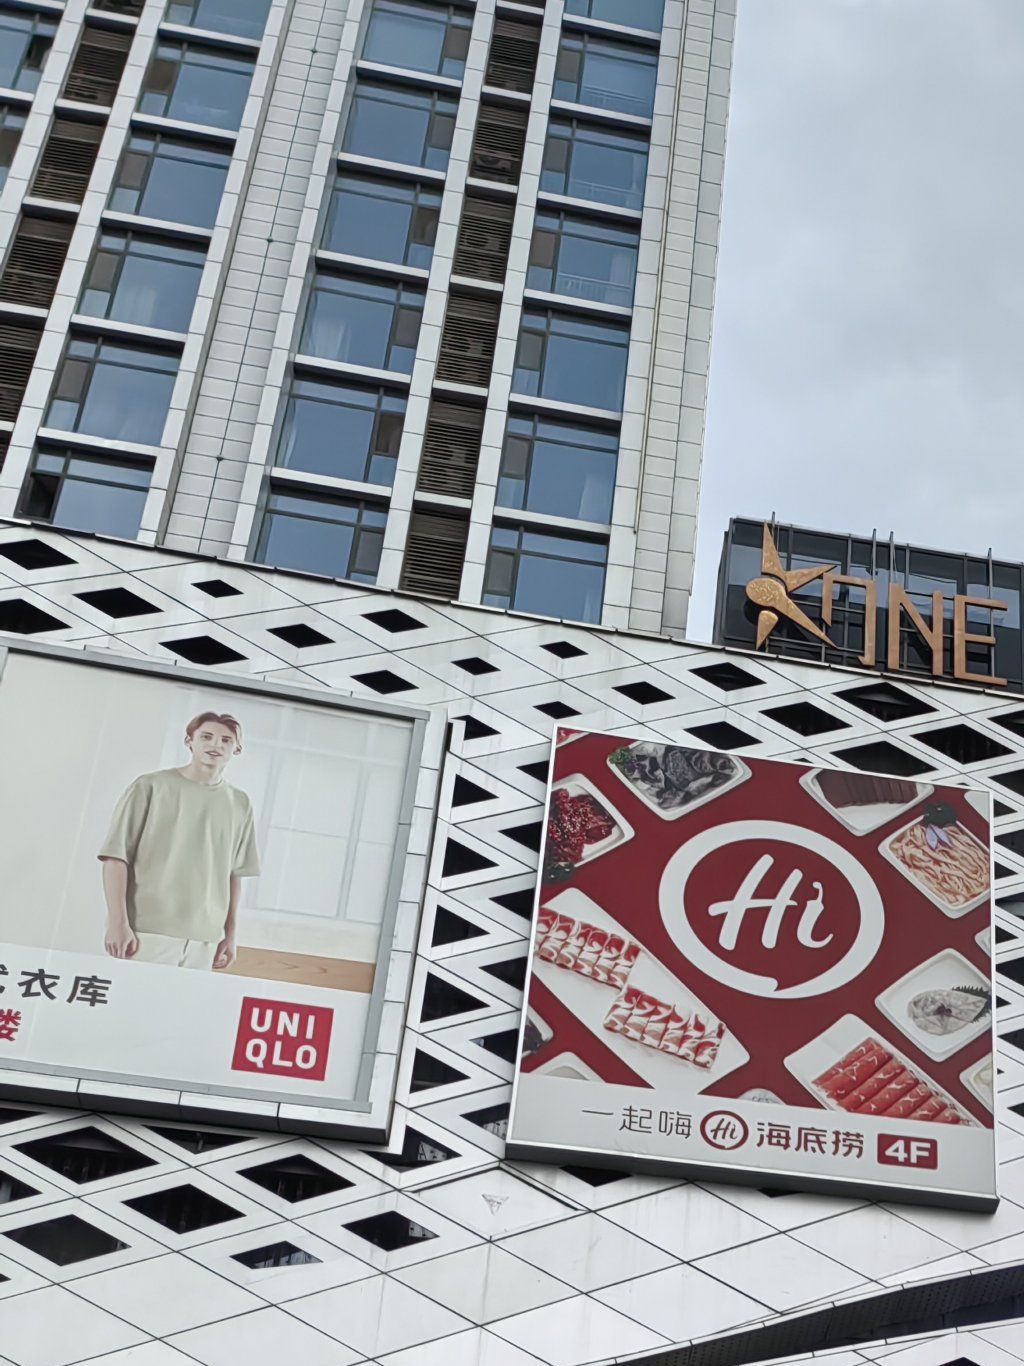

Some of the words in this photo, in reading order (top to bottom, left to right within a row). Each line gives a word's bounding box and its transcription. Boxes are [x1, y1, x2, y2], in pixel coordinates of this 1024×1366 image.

[707, 853, 834, 951] Hi
[250, 1007, 315, 1039] UNI
[244, 1038, 318, 1071] QLO
[581, 1104, 693, 1141] 一起嗨
[755, 1121, 865, 1161] 海底捞
[885, 1141, 931, 1165] 4F
